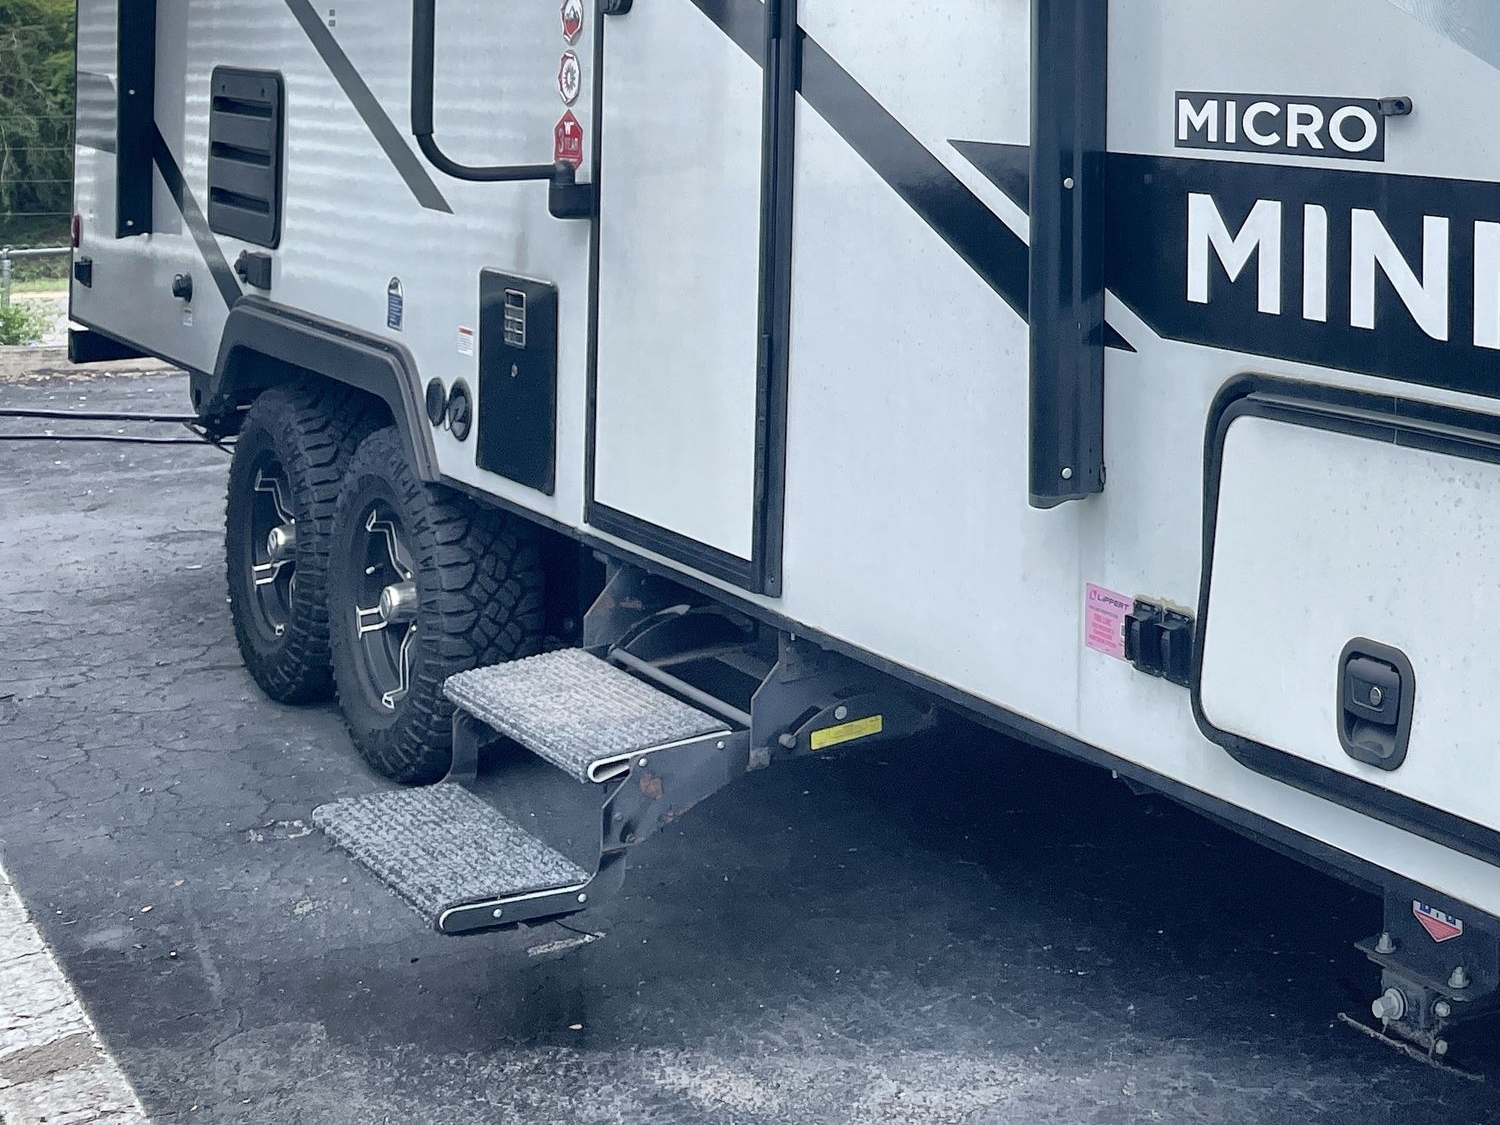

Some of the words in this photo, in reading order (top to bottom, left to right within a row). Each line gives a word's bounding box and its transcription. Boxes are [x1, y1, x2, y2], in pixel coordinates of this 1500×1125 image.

[1177, 98, 1377, 153] MICRO
[564, 136, 579, 151] YEAR
[1097, 595, 1129, 611] LIPPERT
